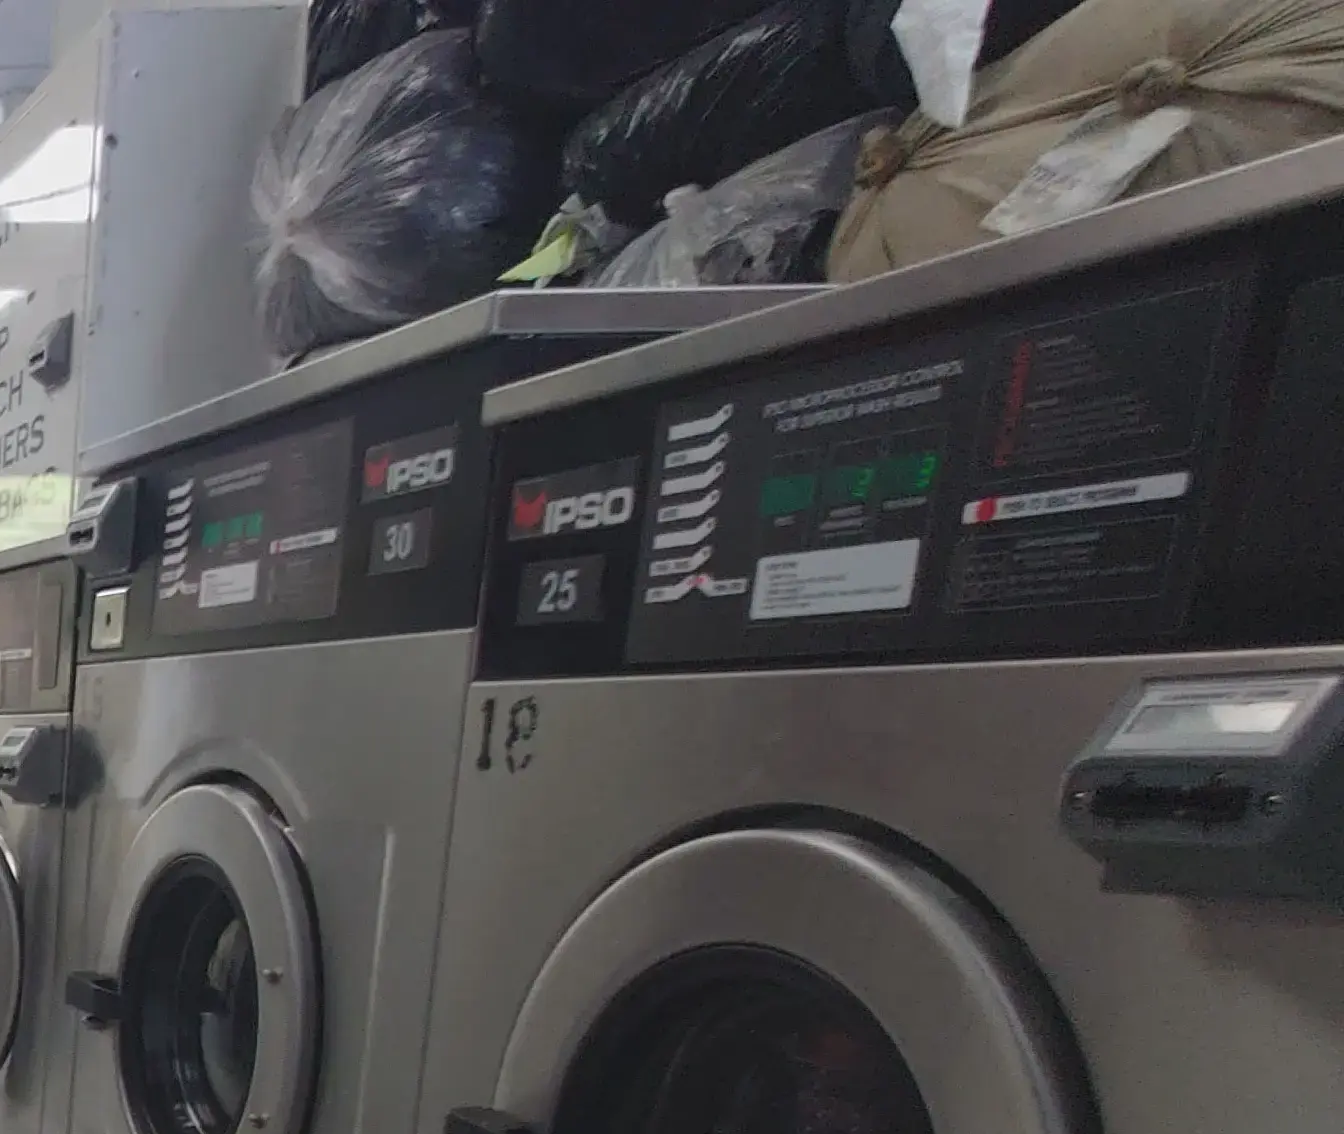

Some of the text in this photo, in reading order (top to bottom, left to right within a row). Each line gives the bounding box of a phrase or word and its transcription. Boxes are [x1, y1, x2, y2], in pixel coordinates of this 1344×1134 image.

[387, 448, 455, 493] IPSO
[542, 486, 636, 534] IPSO
[383, 522, 414, 562] 30
[537, 569, 581, 613] 25
